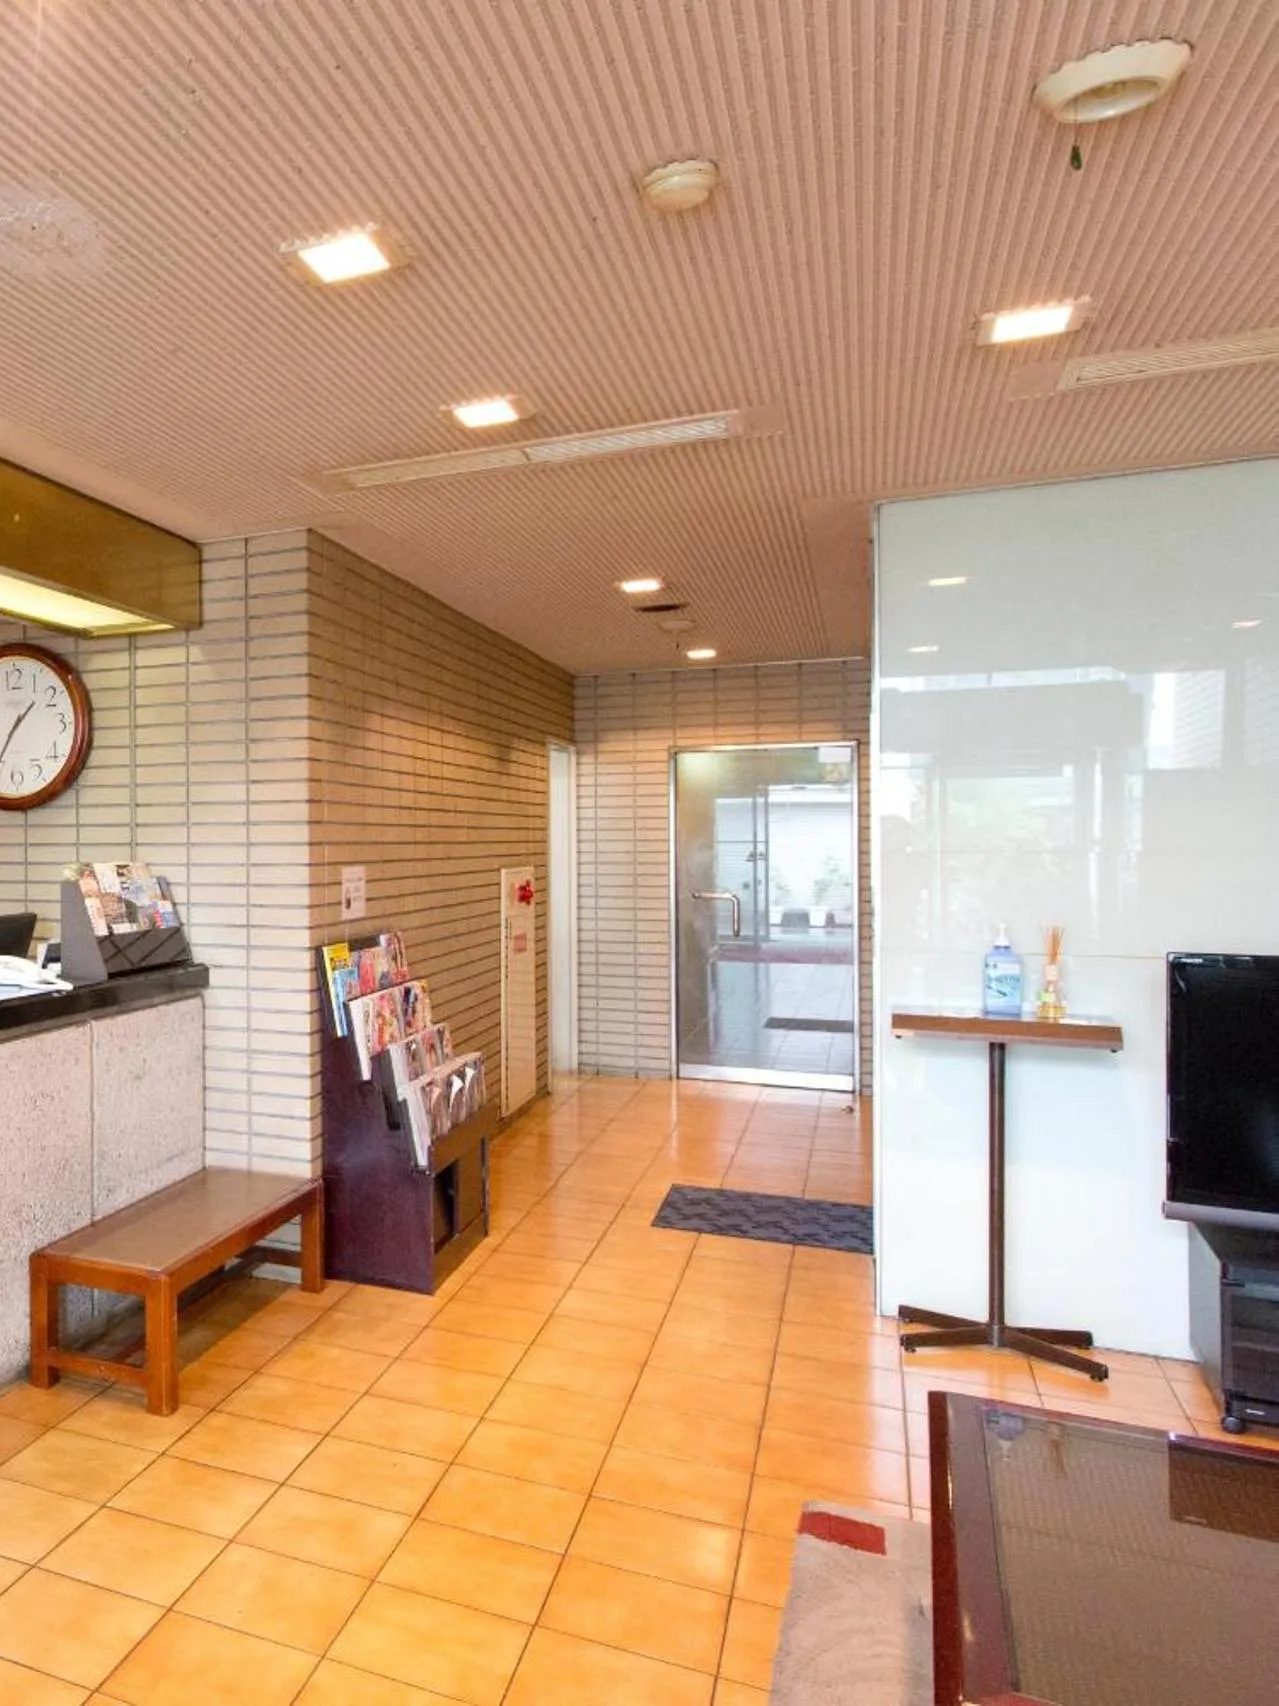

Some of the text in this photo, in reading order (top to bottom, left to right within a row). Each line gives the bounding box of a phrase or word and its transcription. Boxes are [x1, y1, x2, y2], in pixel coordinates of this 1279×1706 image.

[5, 668, 24, 691] 12
[32, 674, 37, 693] 1
[44, 685, 57, 707] 2
[58, 712, 67, 734] 3
[46, 741, 59, 762] 4
[30, 758, 42, 782] 5
